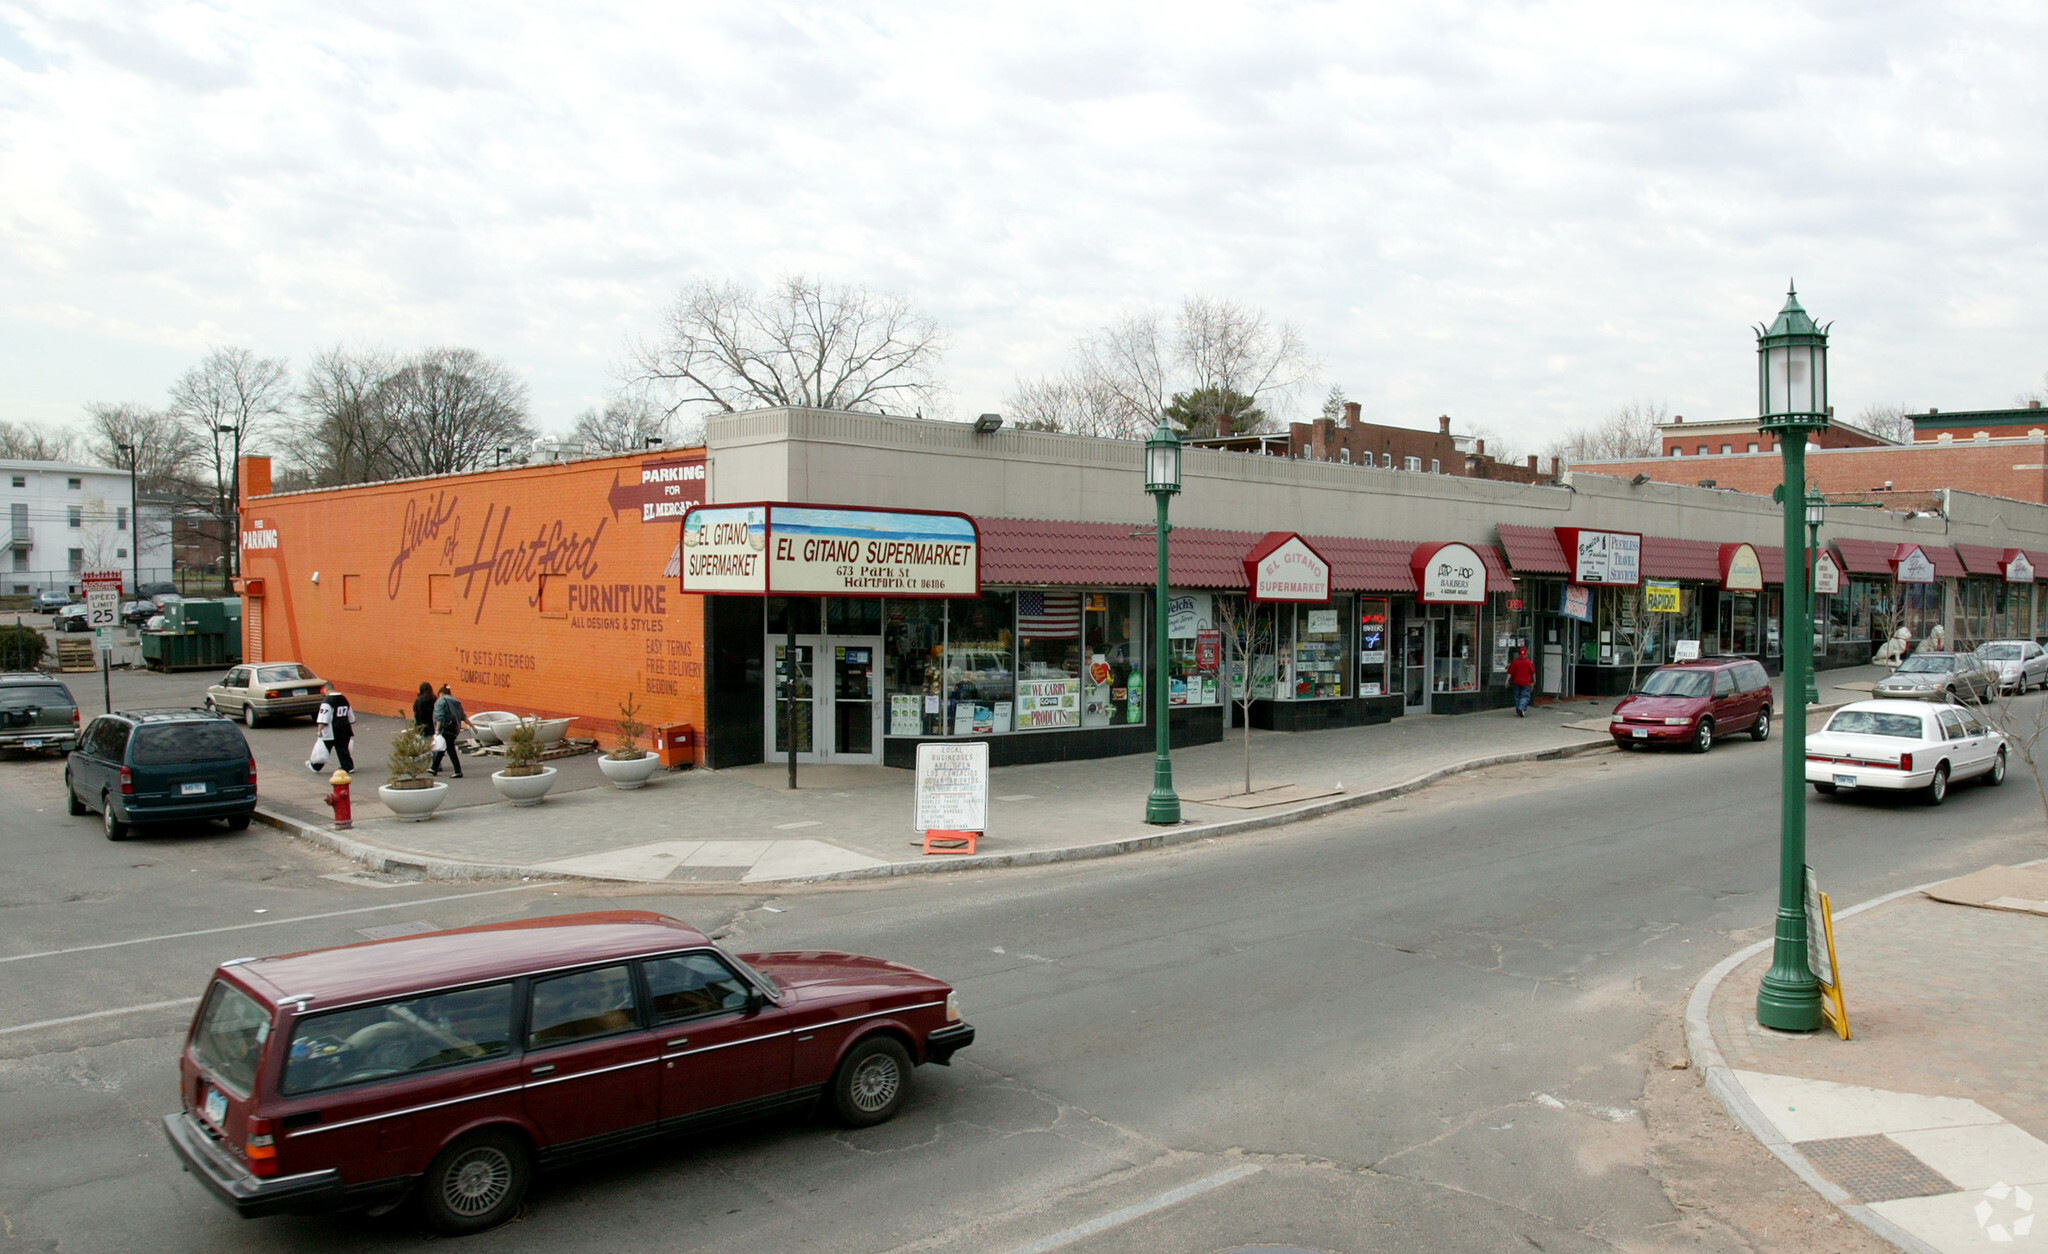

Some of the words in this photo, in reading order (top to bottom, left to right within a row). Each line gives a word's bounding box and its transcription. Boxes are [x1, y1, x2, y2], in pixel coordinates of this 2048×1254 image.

[642, 465, 705, 484] PARKING
[665, 485, 680, 496] FOR
[643, 503, 655, 521] EL
[243, 529, 278, 549] PARKING
[440, 515, 460, 566] of
[698, 524, 709, 546] EL
[714, 522, 748, 546] GITANO
[388, 490, 458, 600] Luis
[777, 538, 795, 561] EL
[803, 539, 860, 563] GITANO
[866, 541, 971, 565] SUPERMARKET
[454, 503, 608, 625] Hartford
[689, 554, 757, 576] SUPERMARKET
[836, 566, 854, 576] 673
[860, 566, 894, 577] Park
[899, 568, 910, 578] St
[1266, 560, 1280, 576] EL
[1284, 553, 1322, 577] GITANO
[921, 579, 946, 589] 06106
[1259, 581, 1325, 593] SUPERMARKET
[89, 593, 117, 601] SPEED
[568, 585, 666, 614] FURNITURE
[93, 609, 114, 623] 25
[571, 617, 585, 629] ALL
[587, 617, 620, 630] DESIGNS
[622, 618, 628, 631] &
[631, 619, 664, 632] STYLES
[460, 649, 470, 664] TV
[646, 639, 662, 655] EASY
[666, 640, 692, 657] TERMS
[646, 658, 665, 675] FREE
[461, 668, 490, 685] COMPACT
[494, 673, 511, 688] DISC
[646, 678, 678, 696] BEDDING
[1032, 683, 1043, 696] WE
[1045, 682, 1066, 696] CARRY
[337, 706, 348, 717] 07
[1031, 709, 1068, 726] PRODUCTS
